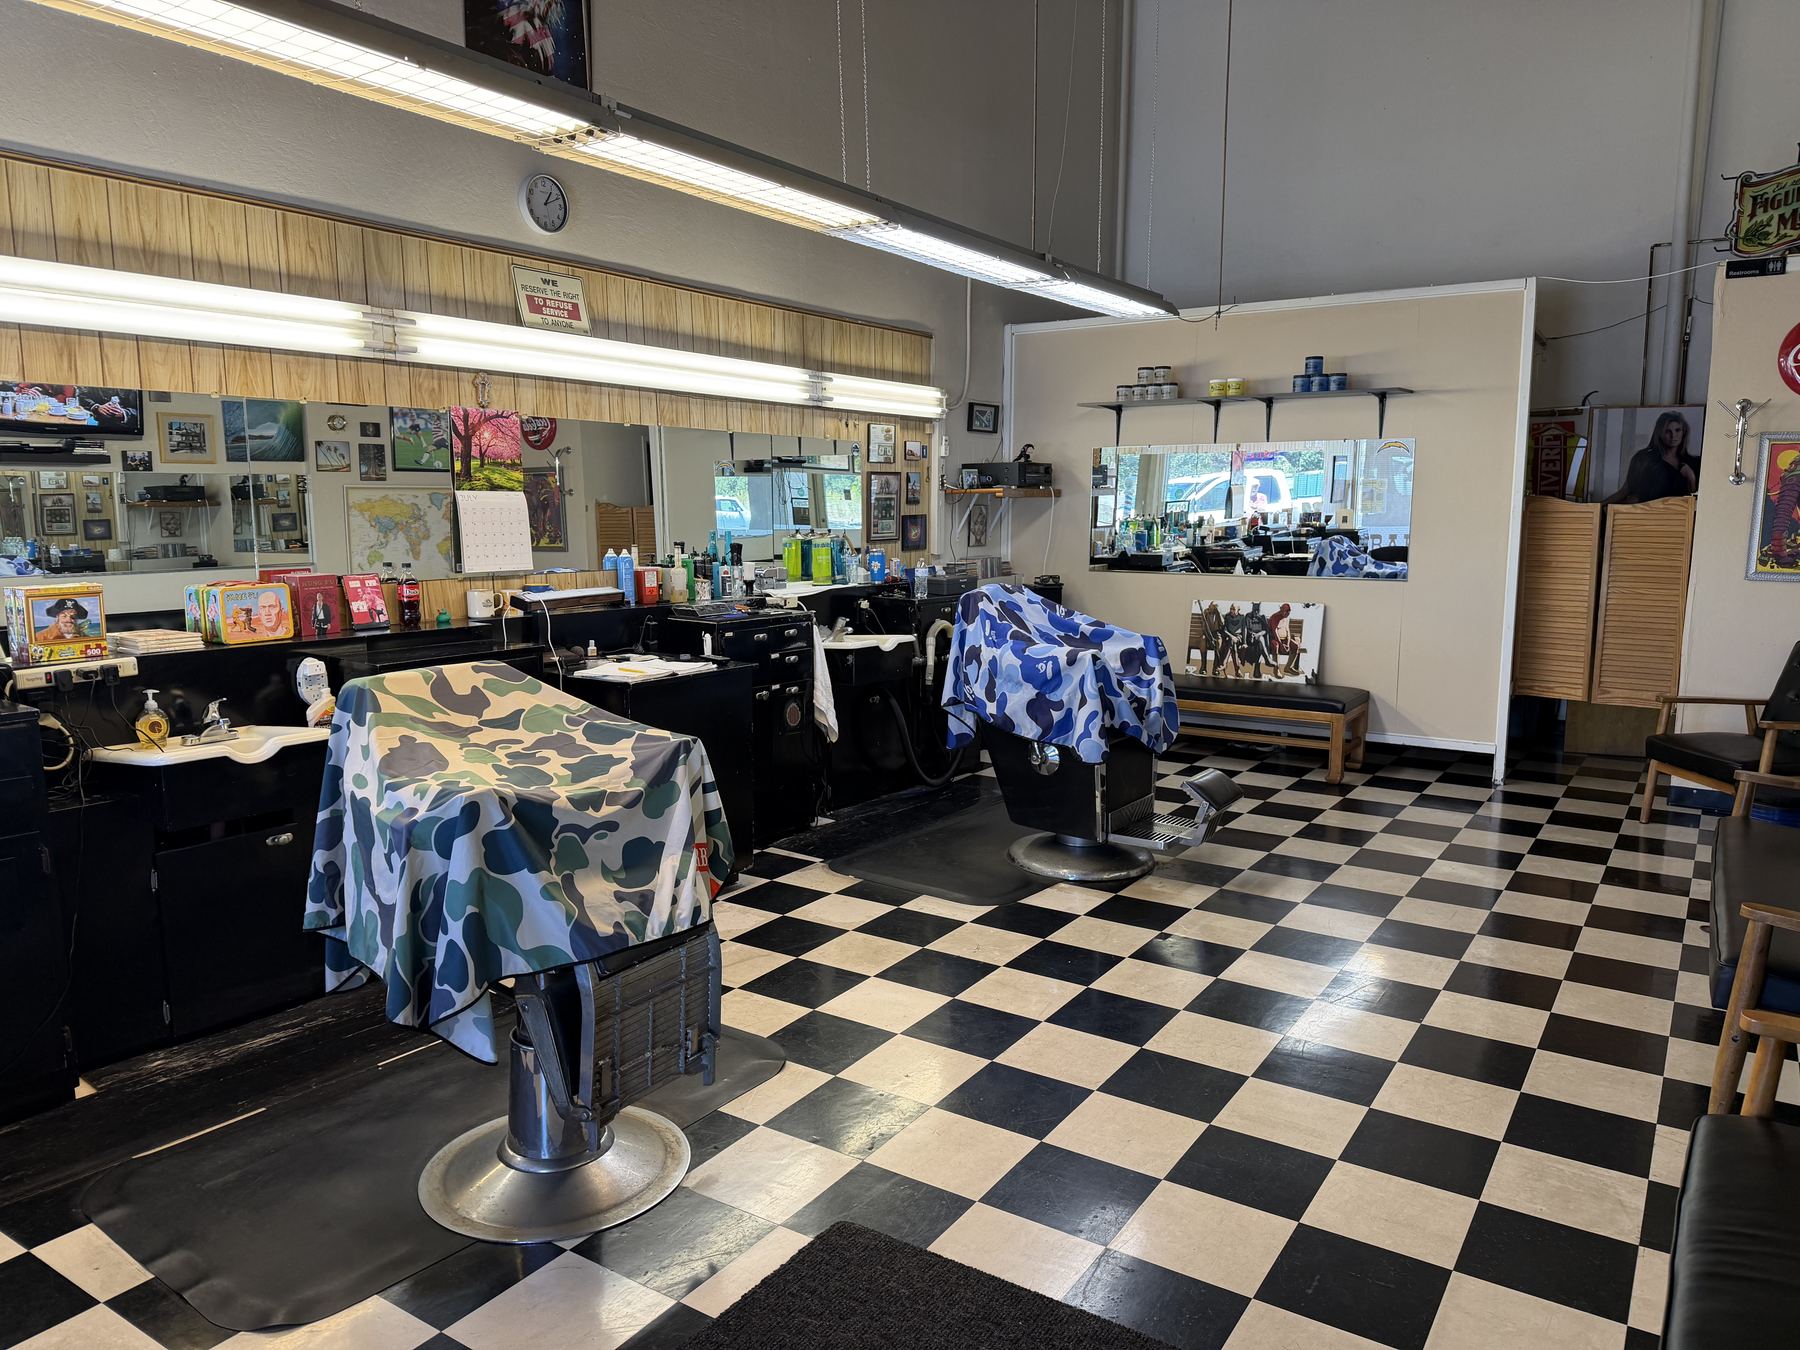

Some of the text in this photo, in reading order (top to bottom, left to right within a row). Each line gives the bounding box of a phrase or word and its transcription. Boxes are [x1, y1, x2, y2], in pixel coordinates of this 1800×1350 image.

[1728, 268, 1760, 277] Restrooms
[540, 277, 559, 287] WE
[520, 283, 580, 302] RESERVE THE RIGHT
[533, 297, 573, 310] TO REFUSE
[542, 308, 569, 318] SERVICE
[541, 317, 575, 329] TO ANYONE
[459, 494, 478, 502] JULY
[86, 648, 101, 656] 500
